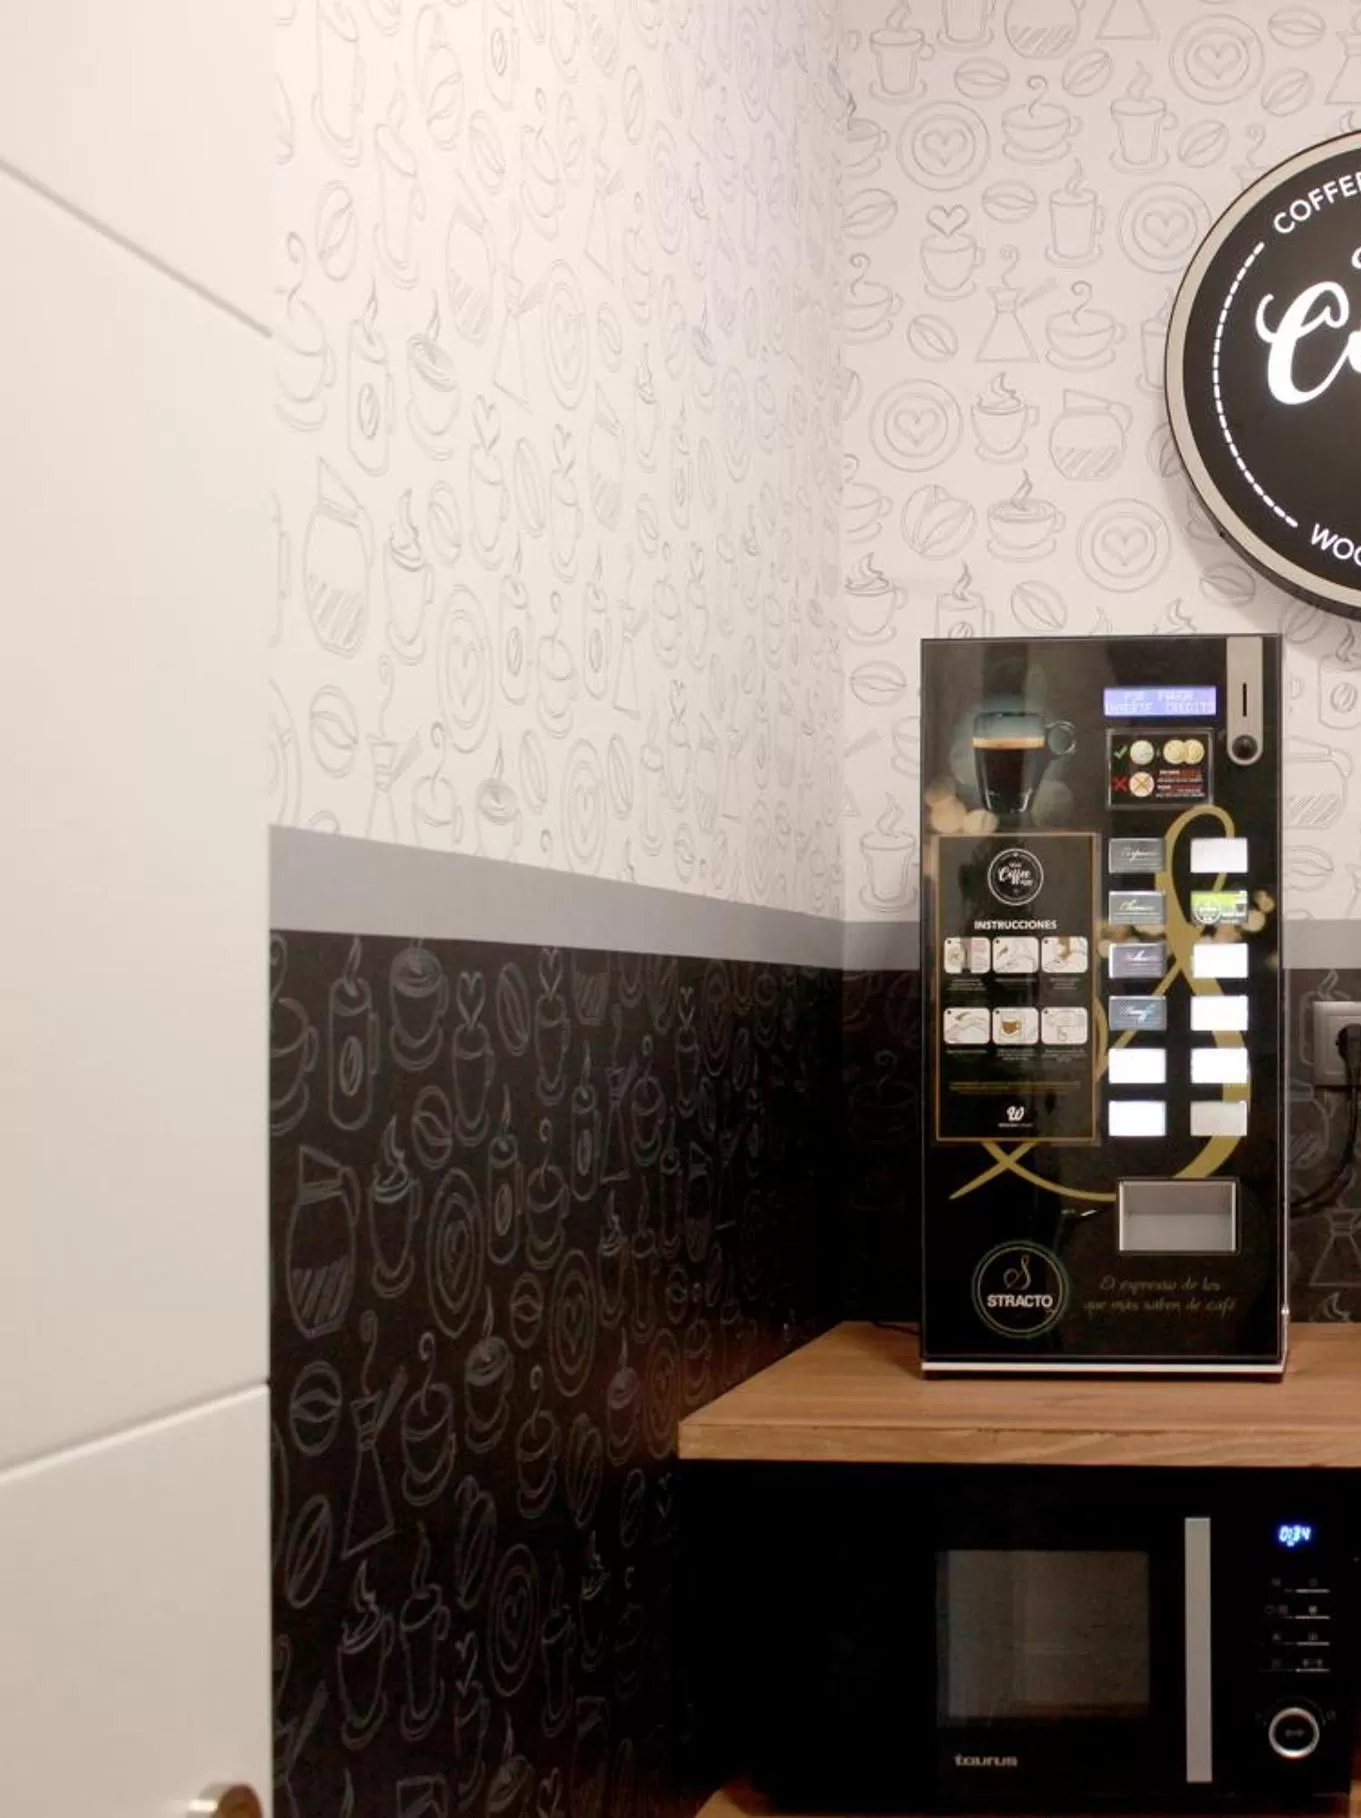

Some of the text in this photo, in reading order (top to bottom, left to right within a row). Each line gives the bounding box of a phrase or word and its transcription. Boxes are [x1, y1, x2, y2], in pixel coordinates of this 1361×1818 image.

[974, 919, 1057, 930] INSTRUCCIONES
[987, 1293, 1054, 1309] STRACTO
[954, 1752, 1019, 1769] taurus
